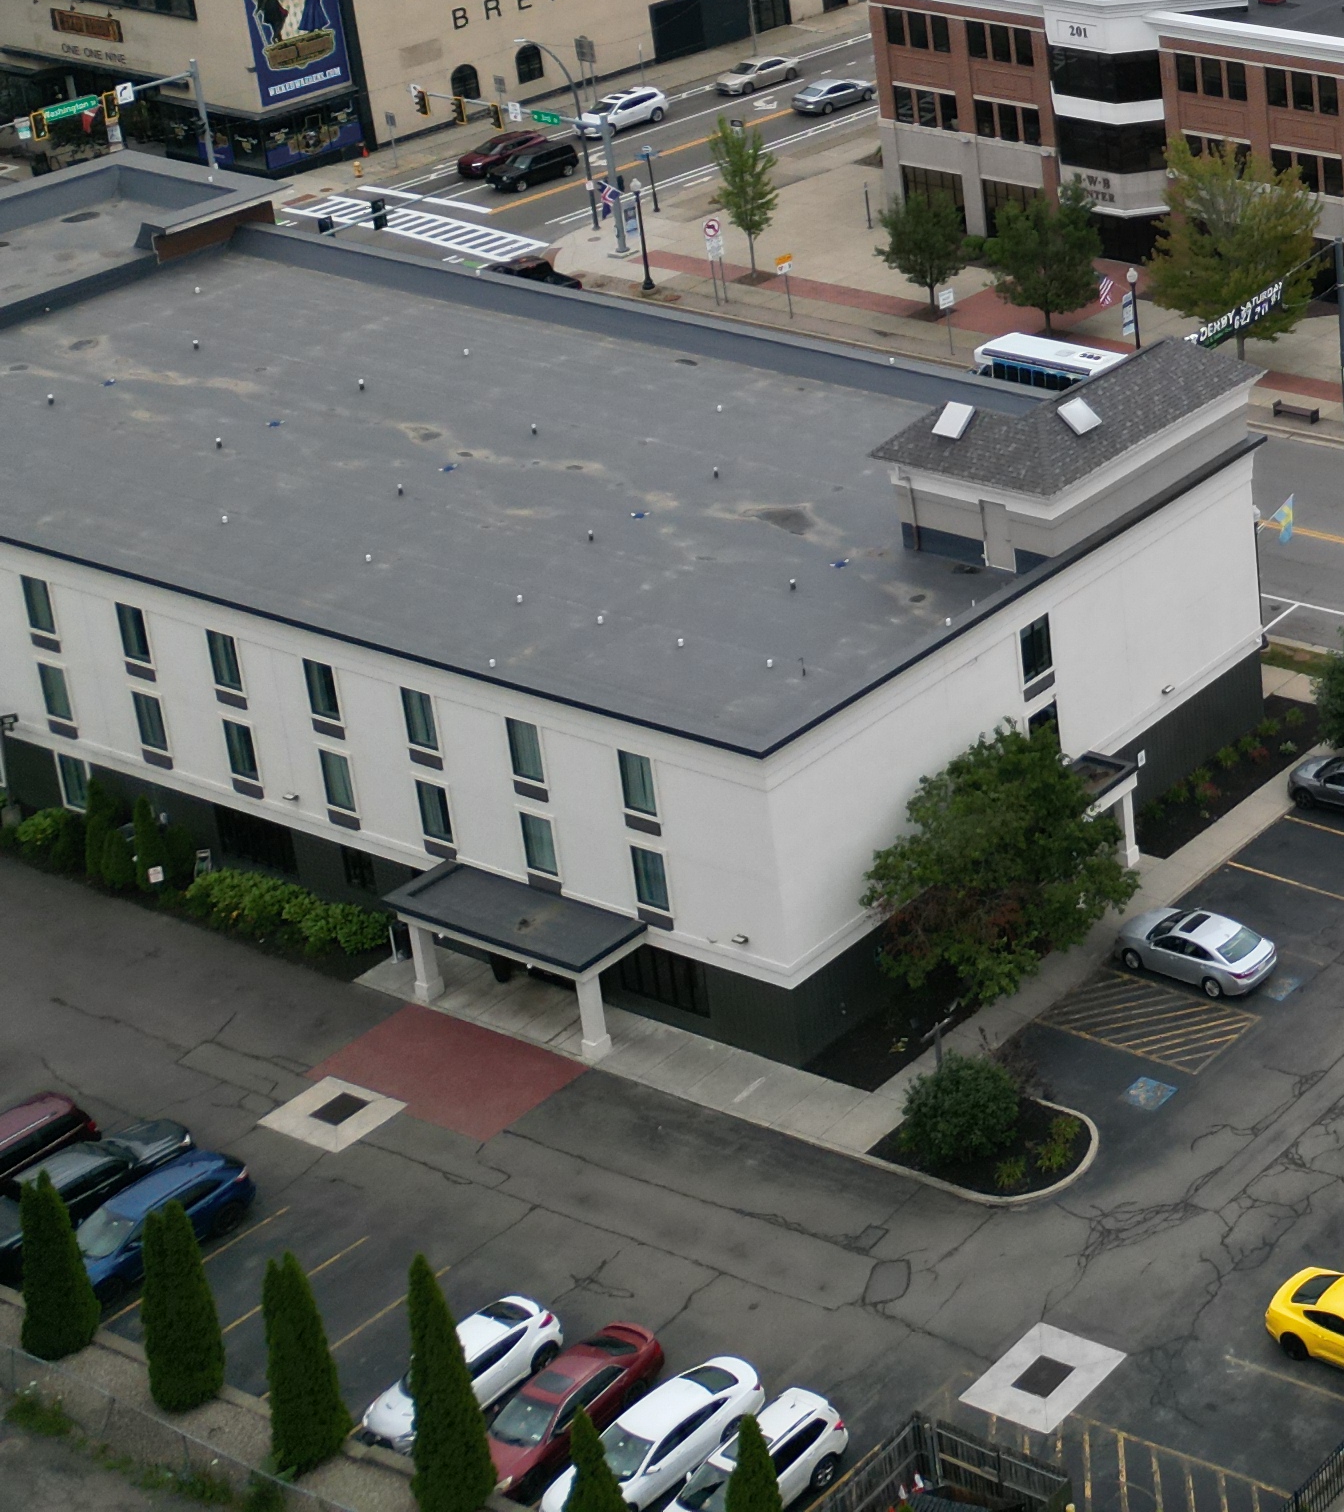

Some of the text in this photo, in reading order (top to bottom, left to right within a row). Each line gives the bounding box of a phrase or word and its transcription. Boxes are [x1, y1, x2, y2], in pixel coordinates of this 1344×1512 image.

[1069, 25, 1088, 38] 201
[61, 42, 127, 65] ONE ONE NINE
[44, 101, 89, 119] Washington
[1199, 309, 1236, 342] DERBY
